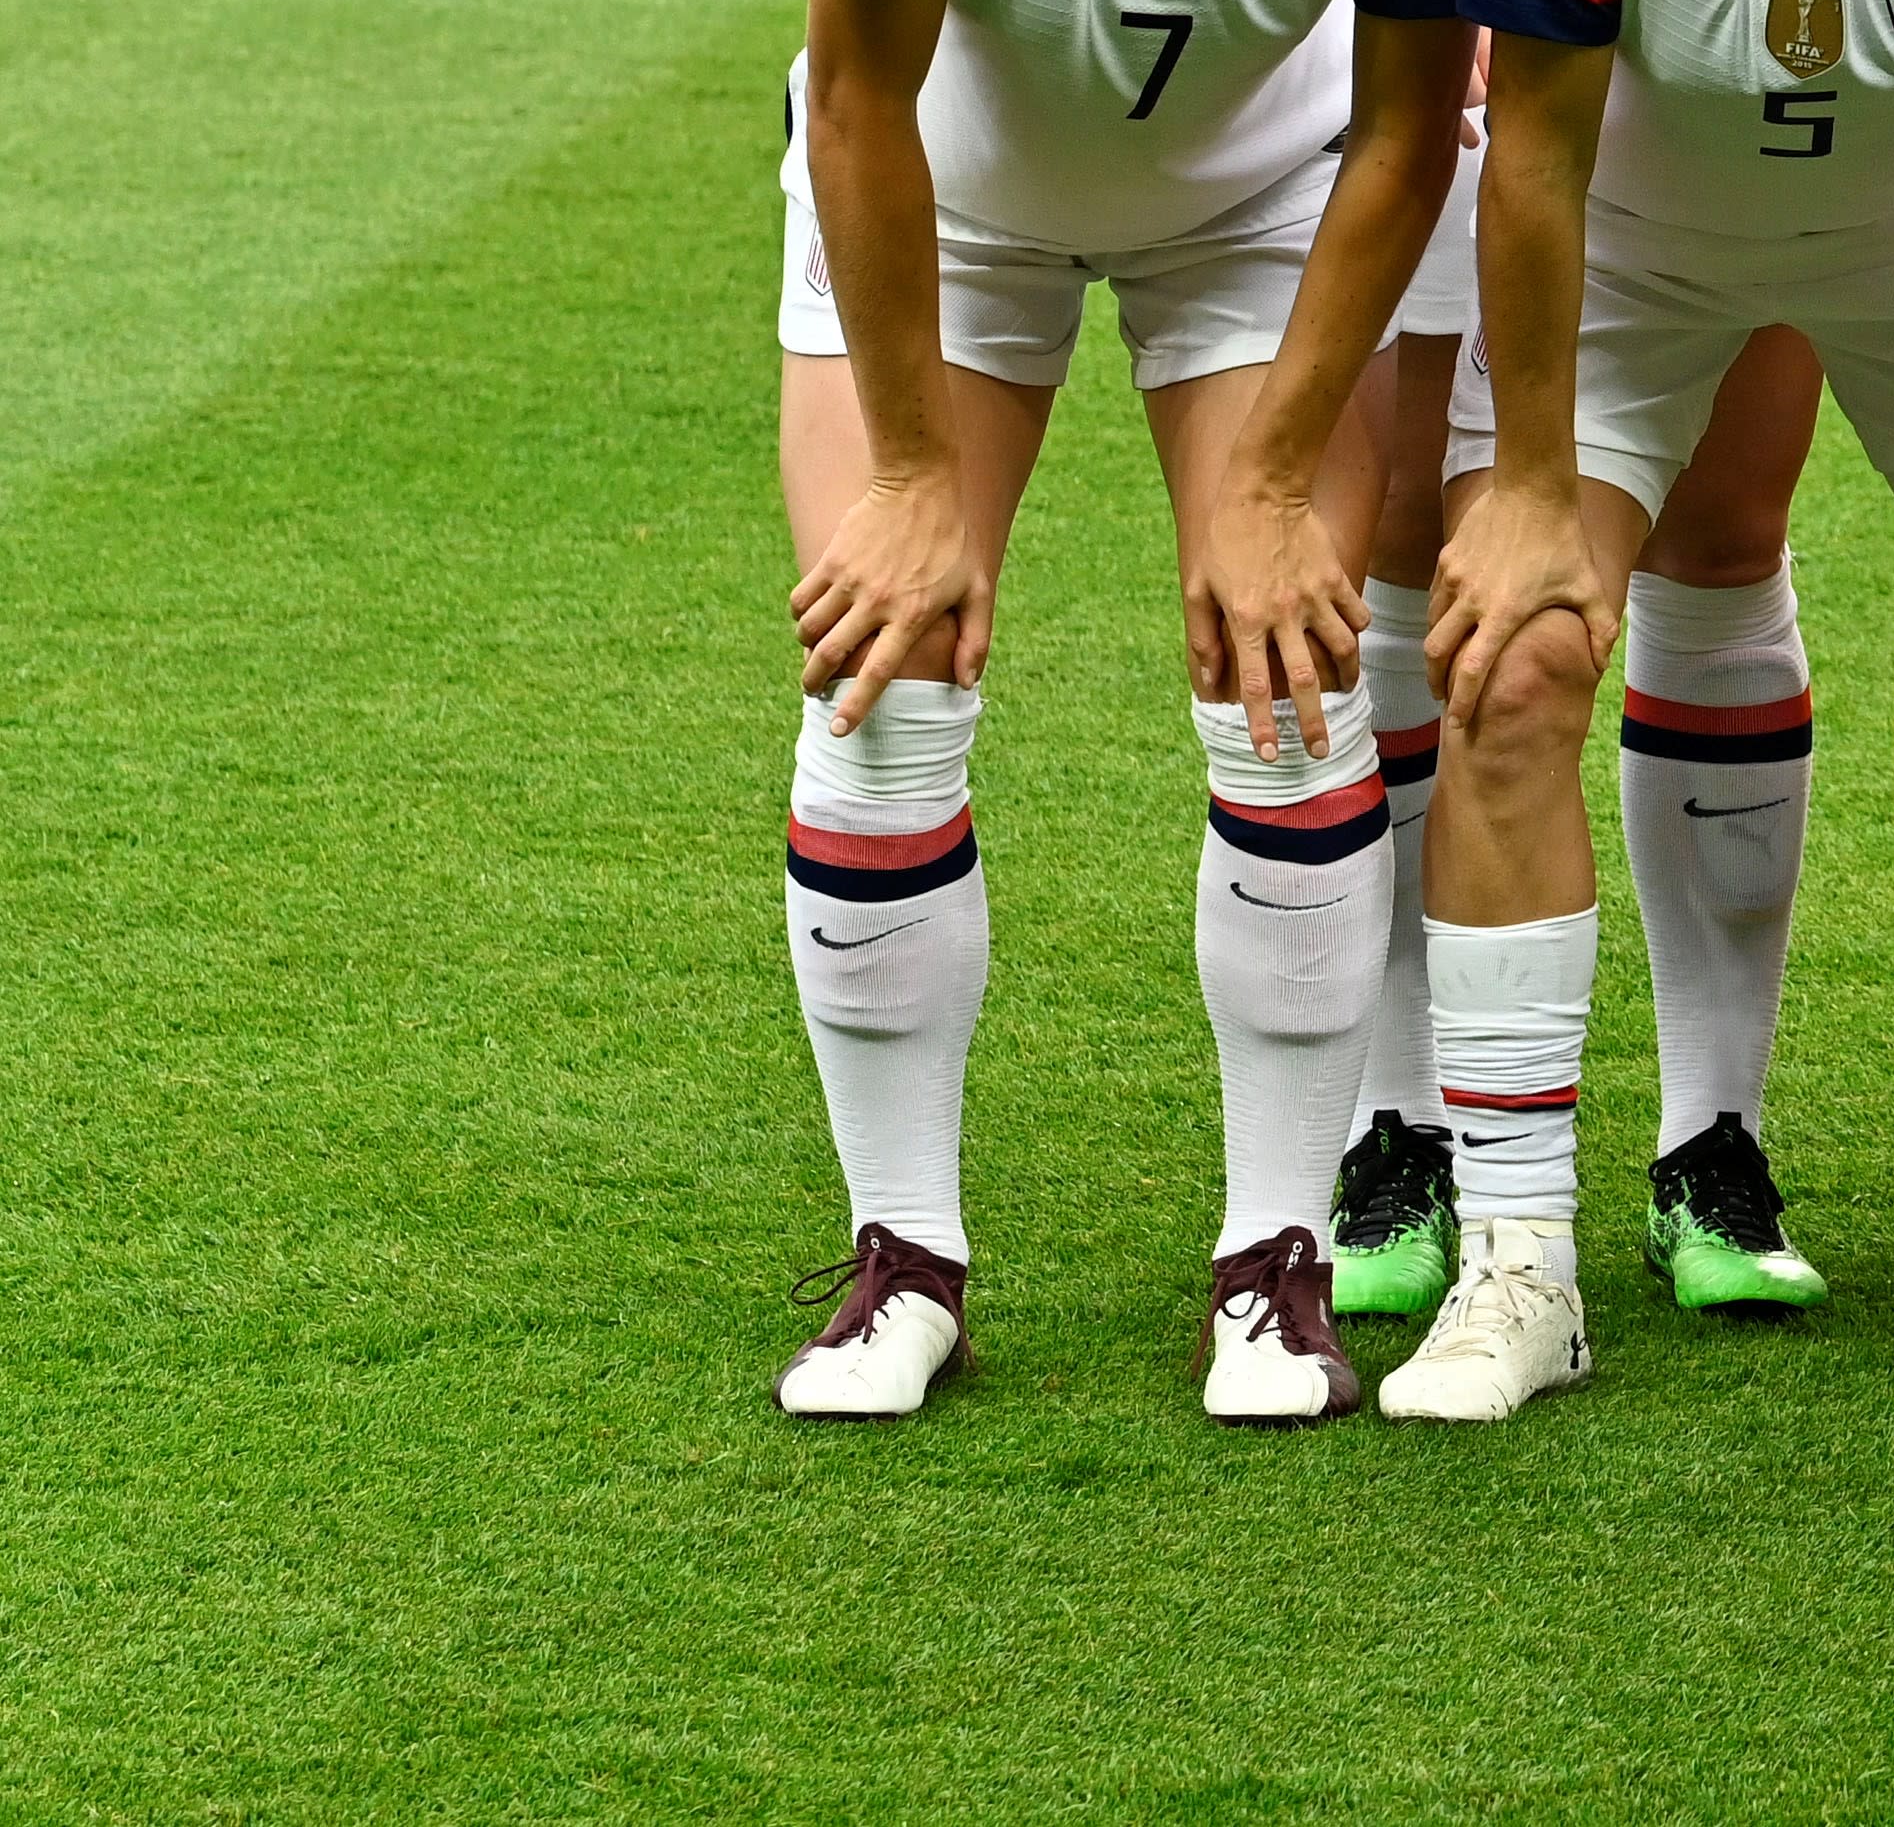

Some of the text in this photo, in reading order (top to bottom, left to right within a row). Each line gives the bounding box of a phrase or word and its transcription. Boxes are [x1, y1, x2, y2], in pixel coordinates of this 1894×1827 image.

[1119, 11, 1193, 120] 7
[1785, 43, 1820, 58] FIFA
[1759, 90, 1838, 159] 5
